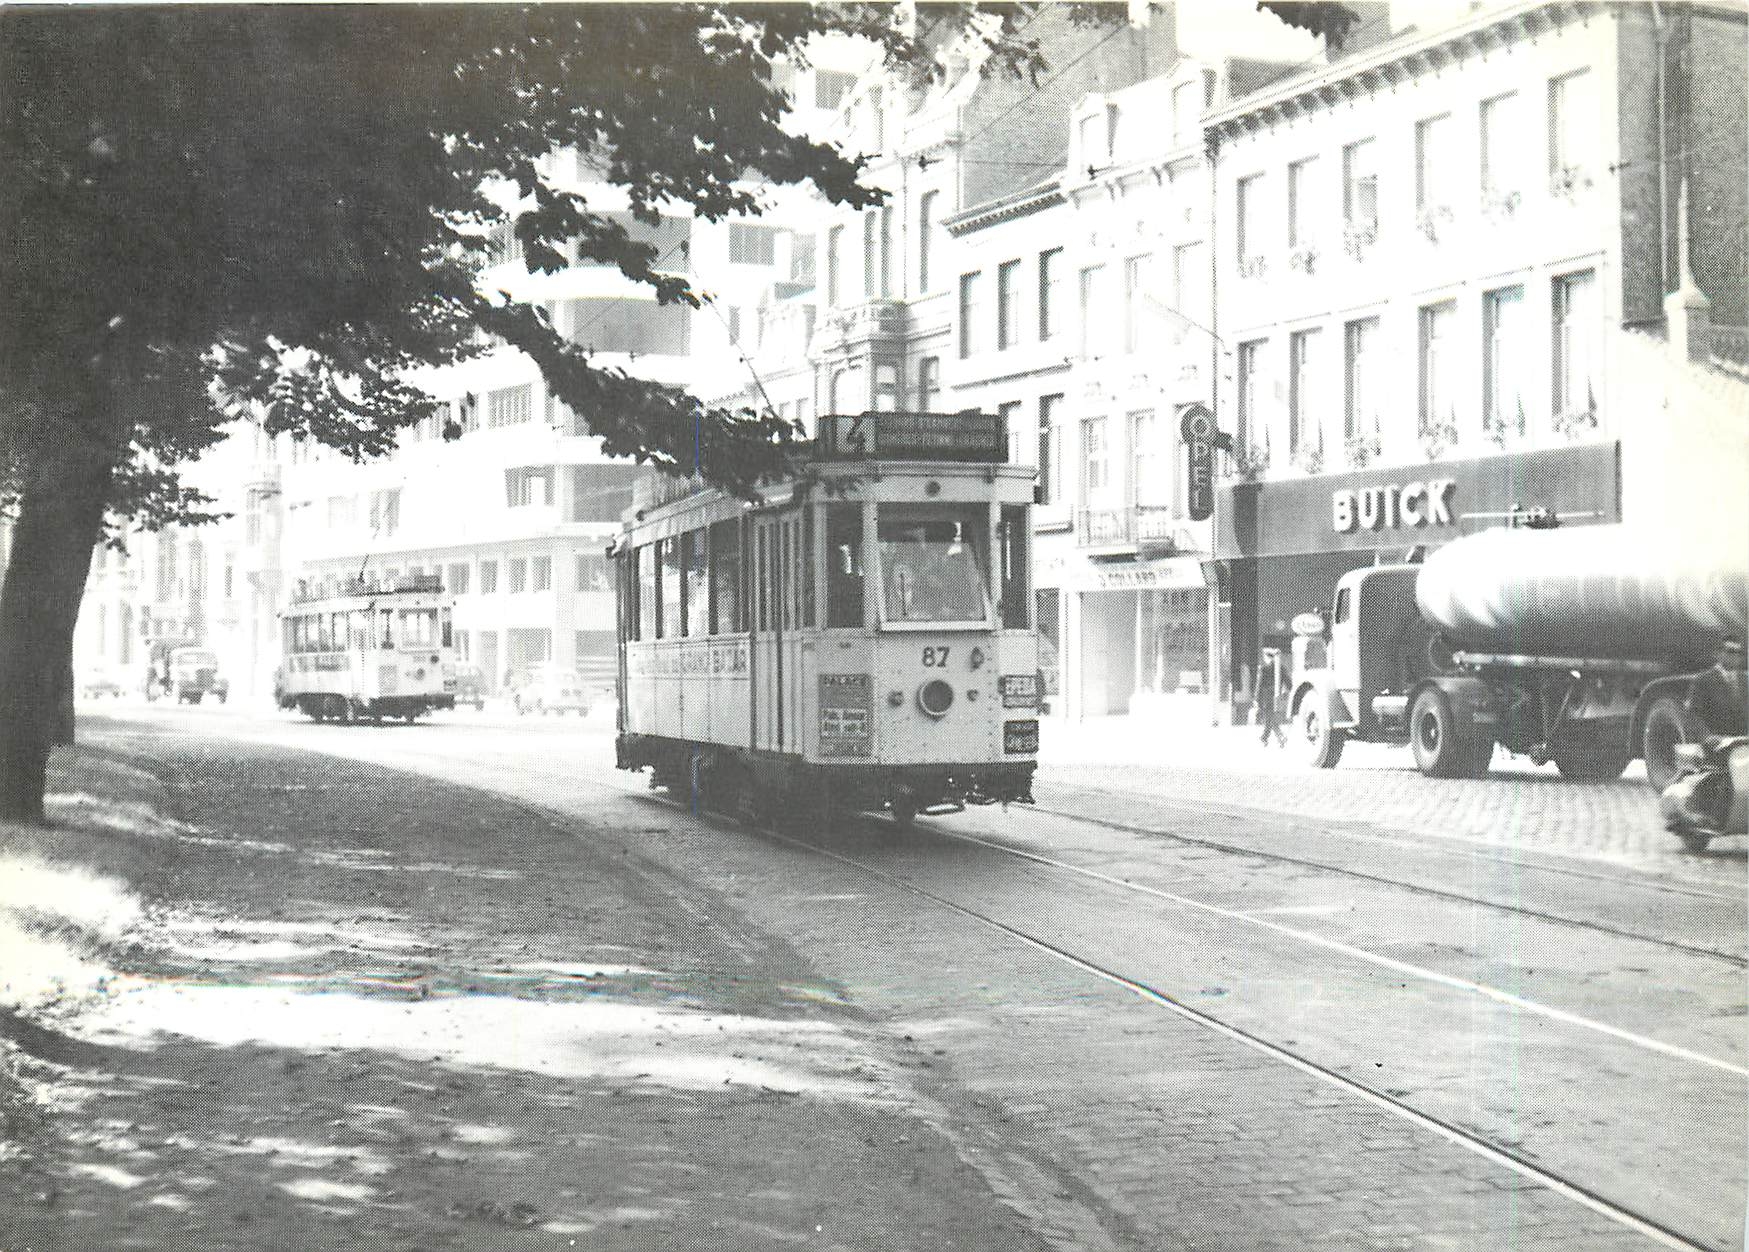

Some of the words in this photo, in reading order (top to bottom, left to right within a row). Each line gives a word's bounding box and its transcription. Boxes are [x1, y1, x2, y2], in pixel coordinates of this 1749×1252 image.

[1189, 415, 1211, 509] OPEL
[1332, 478, 1456, 533] BUICK
[922, 646, 950, 668] 87
